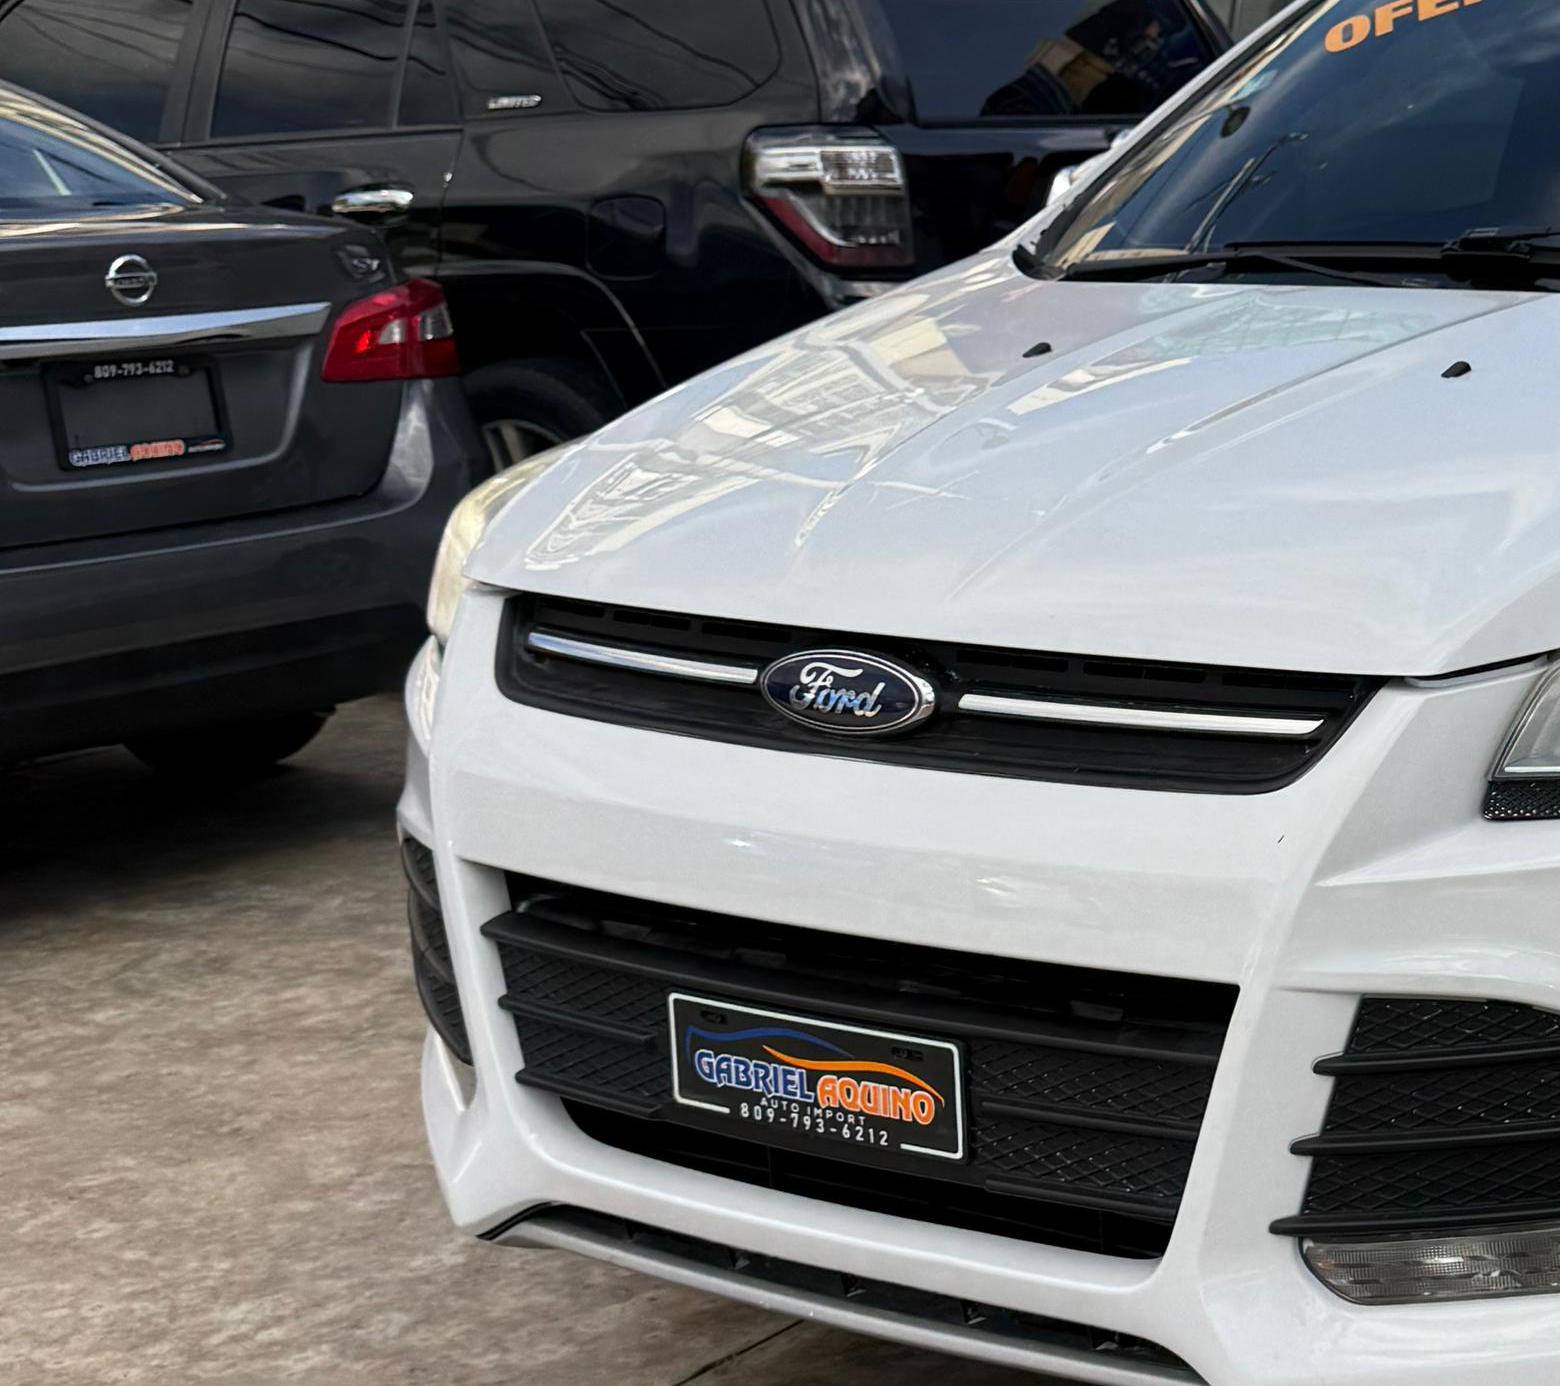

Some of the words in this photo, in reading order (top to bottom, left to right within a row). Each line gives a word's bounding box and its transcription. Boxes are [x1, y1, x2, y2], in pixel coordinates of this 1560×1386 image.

[789, 662, 886, 718] Ford
[695, 1049, 815, 1103] GABRIEL
[817, 1074, 935, 1125] AQUINO
[760, 1097, 799, 1113] AUTO
[807, 1106, 866, 1126] IMPORT
[740, 1102, 888, 1146] 809-793-6212
